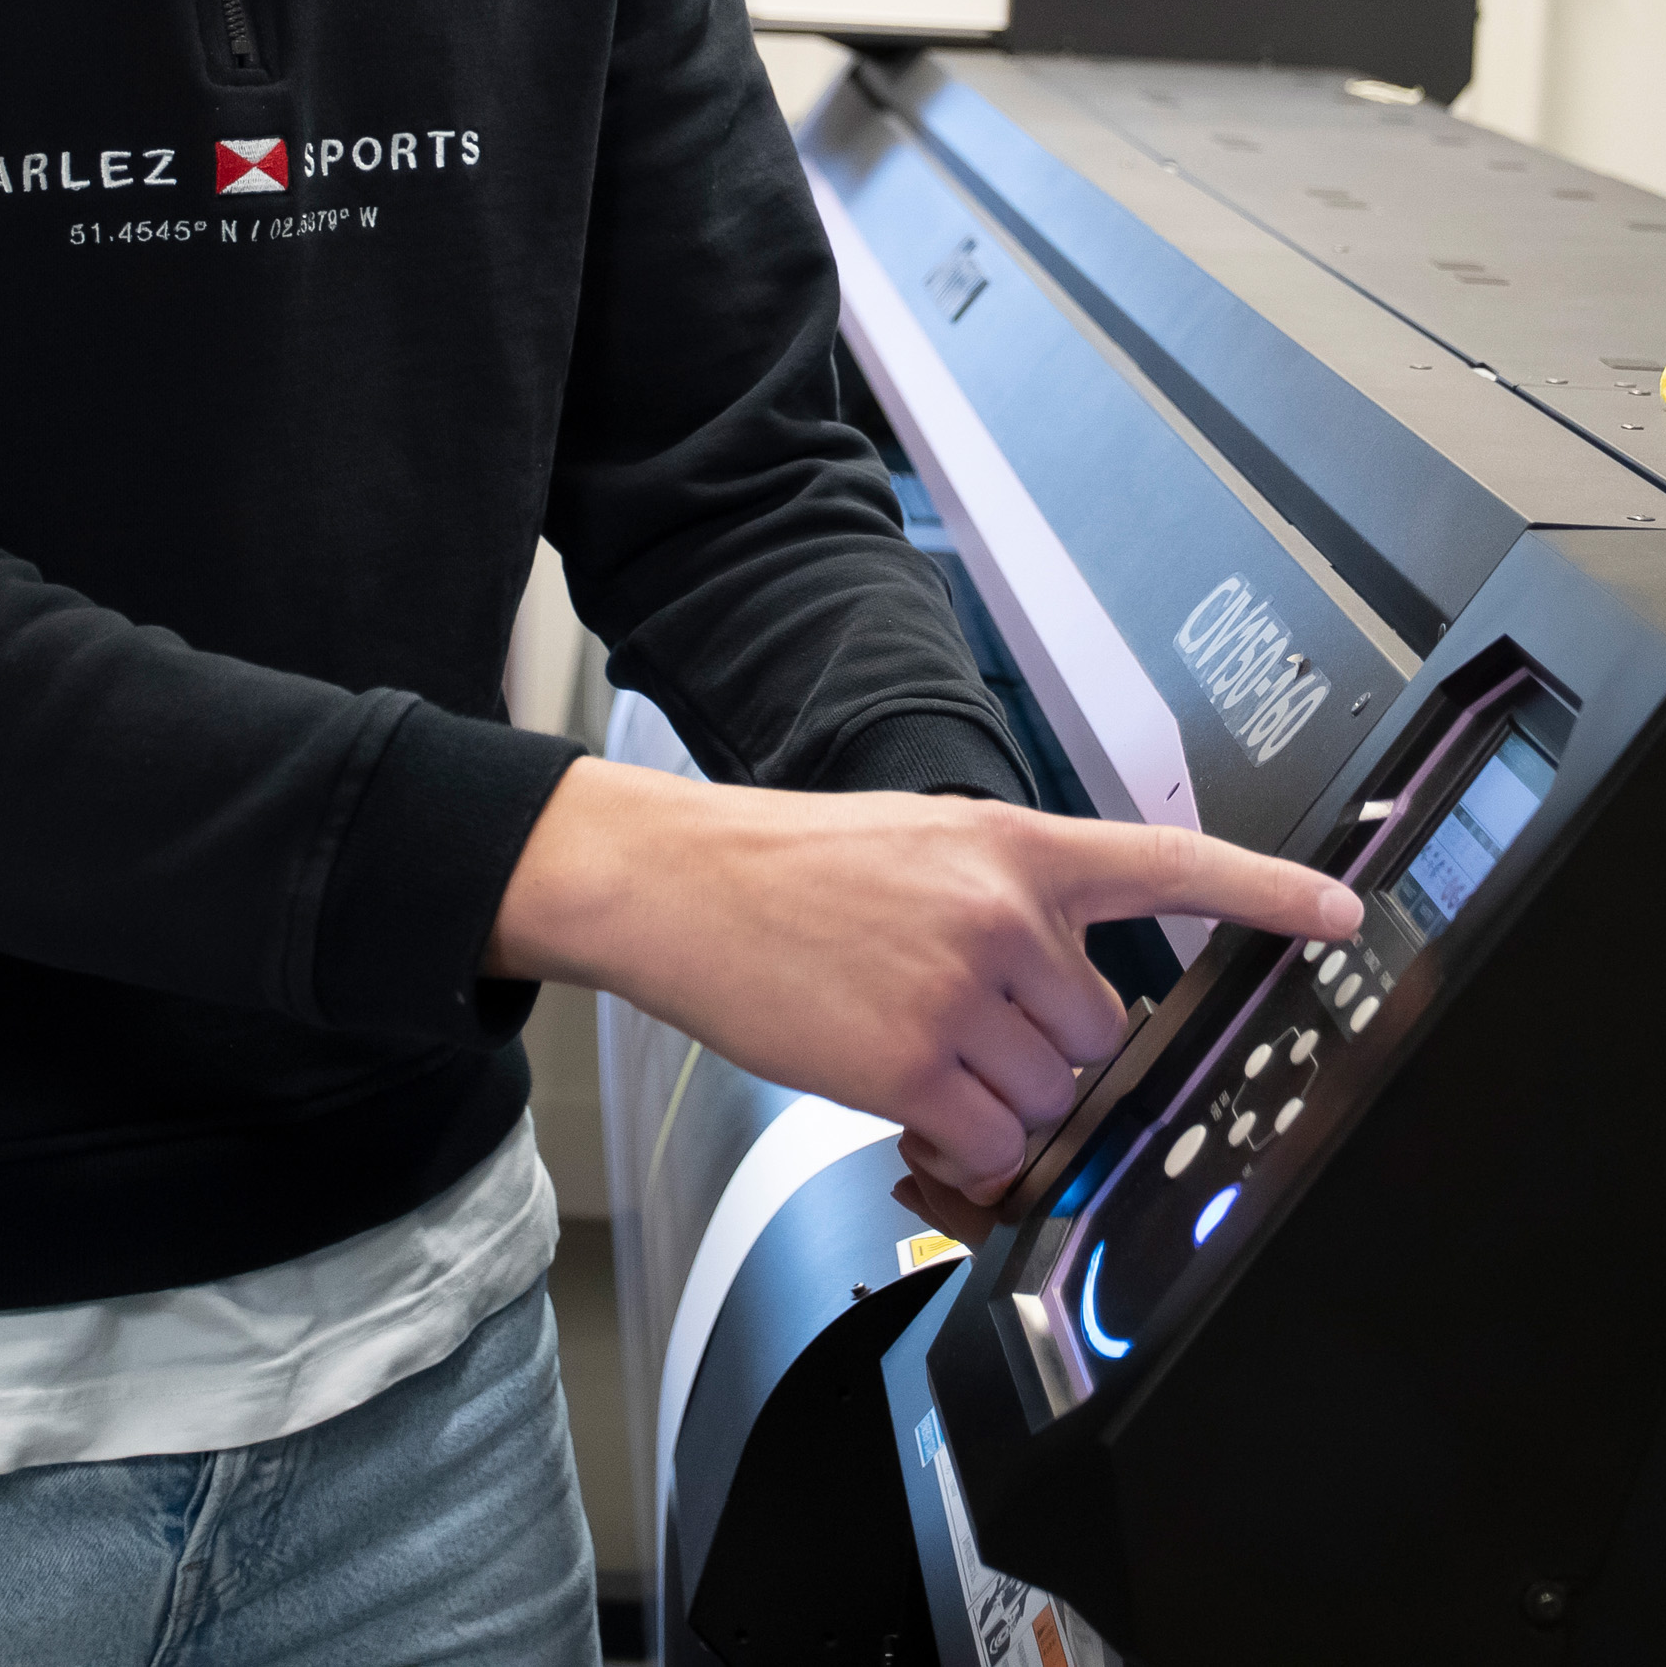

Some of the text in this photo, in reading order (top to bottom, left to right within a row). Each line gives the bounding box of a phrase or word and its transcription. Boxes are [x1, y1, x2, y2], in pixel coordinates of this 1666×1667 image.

[303, 130, 481, 178] SPORTS
[69, 219, 207, 245] 51.4545°
[221, 219, 237, 243] N
[359, 205, 378, 228] W
